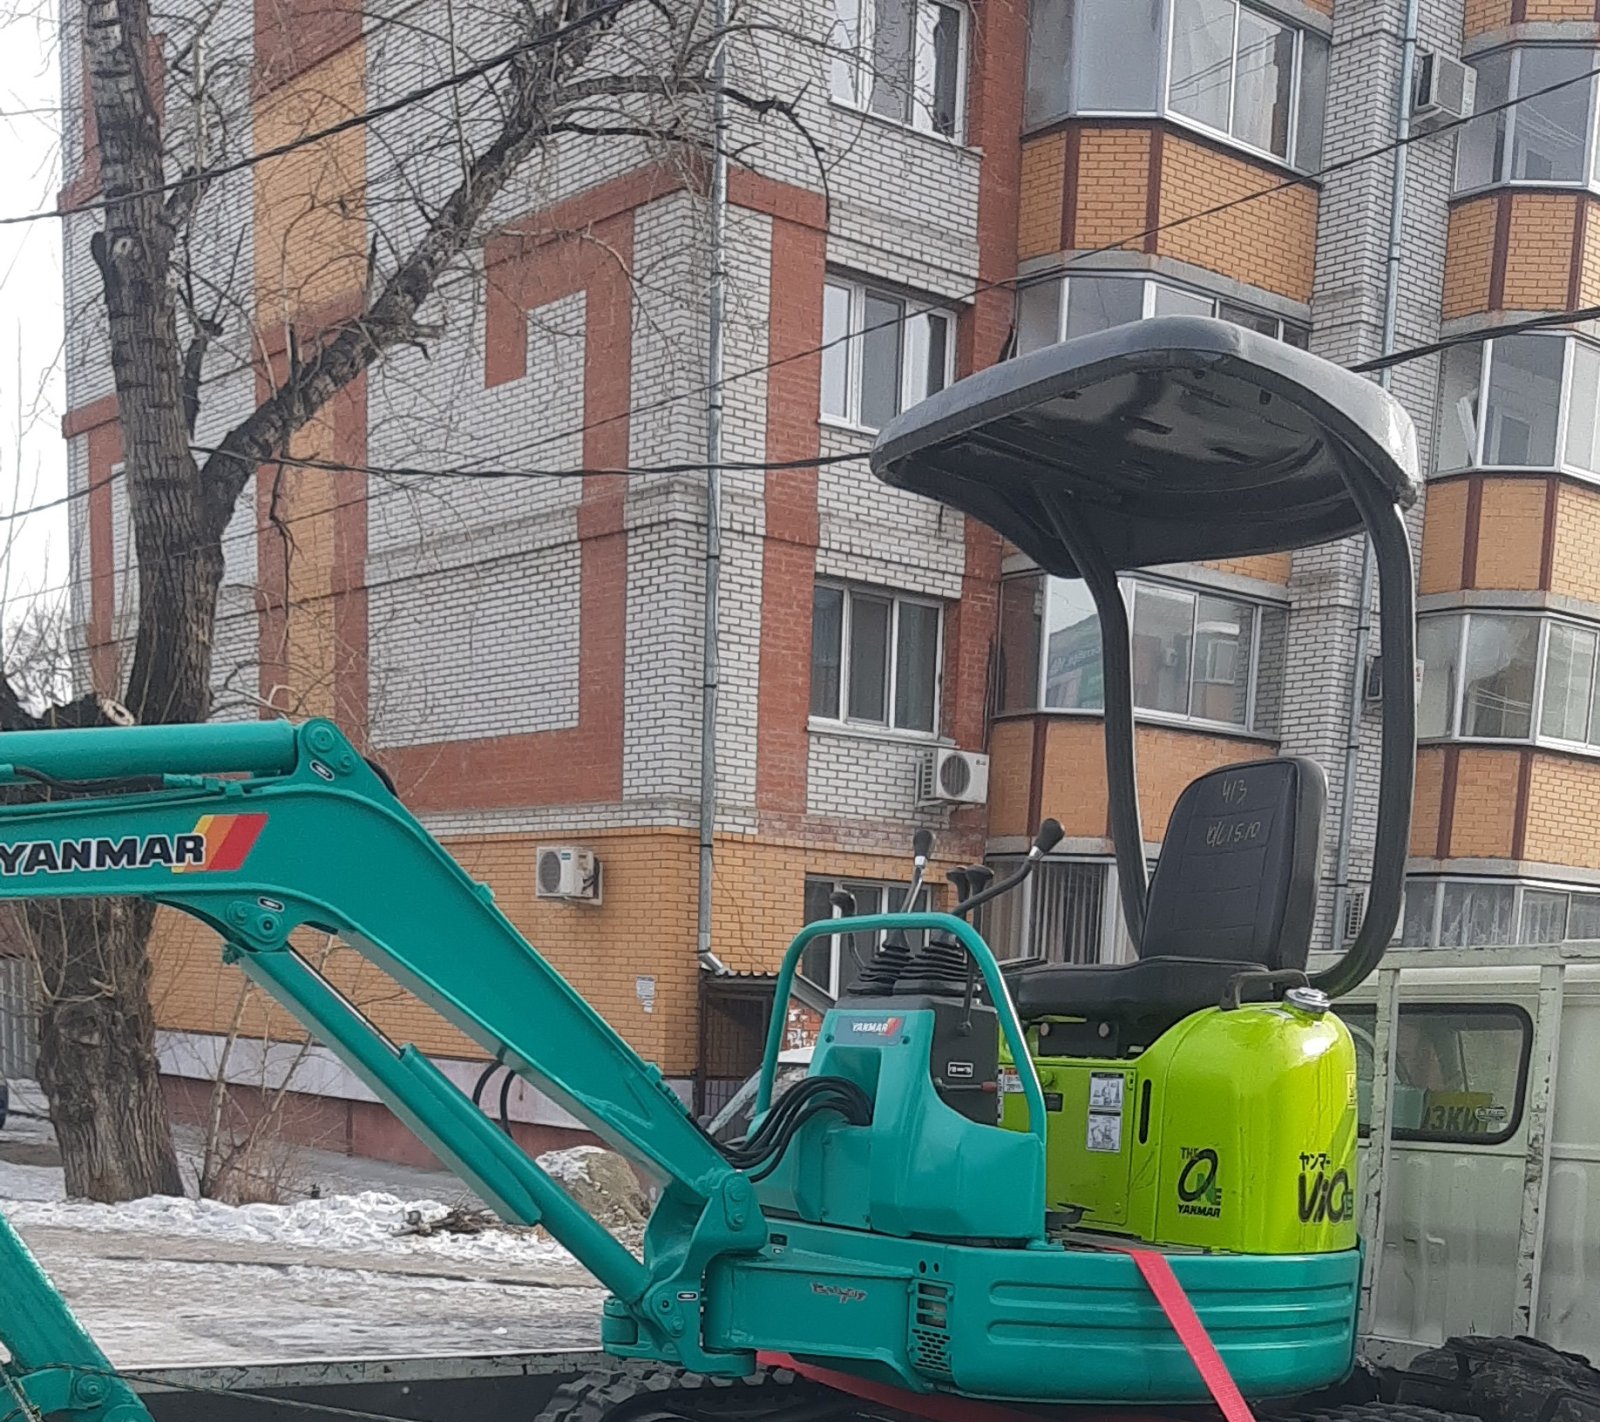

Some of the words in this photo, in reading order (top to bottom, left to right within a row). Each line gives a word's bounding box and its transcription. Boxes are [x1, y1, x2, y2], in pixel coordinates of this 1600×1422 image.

[0, 833, 205, 875] YANMAR
[852, 1021, 889, 1033] YANMAR
[1299, 1152, 1330, 1171] ヤンマー
[1178, 1204, 1221, 1219] YANMAR
